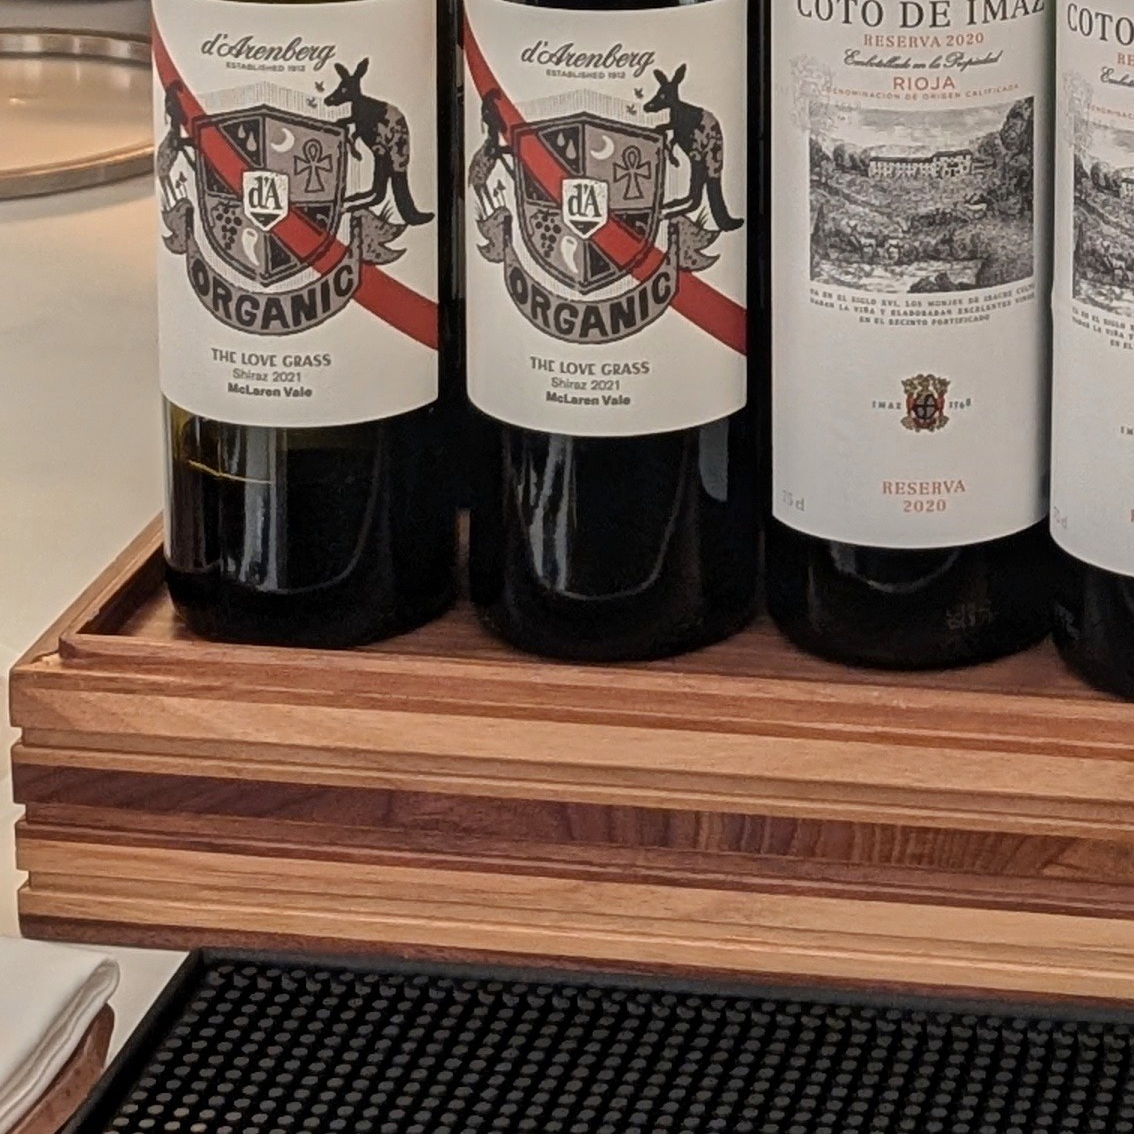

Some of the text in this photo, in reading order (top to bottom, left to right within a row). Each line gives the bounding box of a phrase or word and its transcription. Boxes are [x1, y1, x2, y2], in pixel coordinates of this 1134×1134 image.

[900, 0, 951, 29] DE
[1067, 3, 1134, 46] COTO
[863, 32, 984, 48] RESERVA 2020
[201, 33, 336, 71] d'Arenberg
[521, 40, 655, 78] d'Arenberg
[226, 61, 285, 72] ESTABLISHED
[546, 69, 605, 79] ESTABLISHED
[893, 75, 956, 91] RIOJA
[904, 93, 918, 101] DE
[191, 258, 355, 329] ORGANIC
[509, 267, 671, 338] ORGANIC
[211, 348, 332, 367] THE LOVE GRASS
[530, 356, 650, 375] THE LOVE GRASS
[233, 369, 301, 382] Shiraz 2021
[228, 383, 312, 397] McLaren Vale
[551, 377, 620, 391] Shiraz 2021
[546, 391, 631, 406] McLaren Vale
[882, 480, 966, 495] RESERVA
[903, 499, 946, 513] 2020
